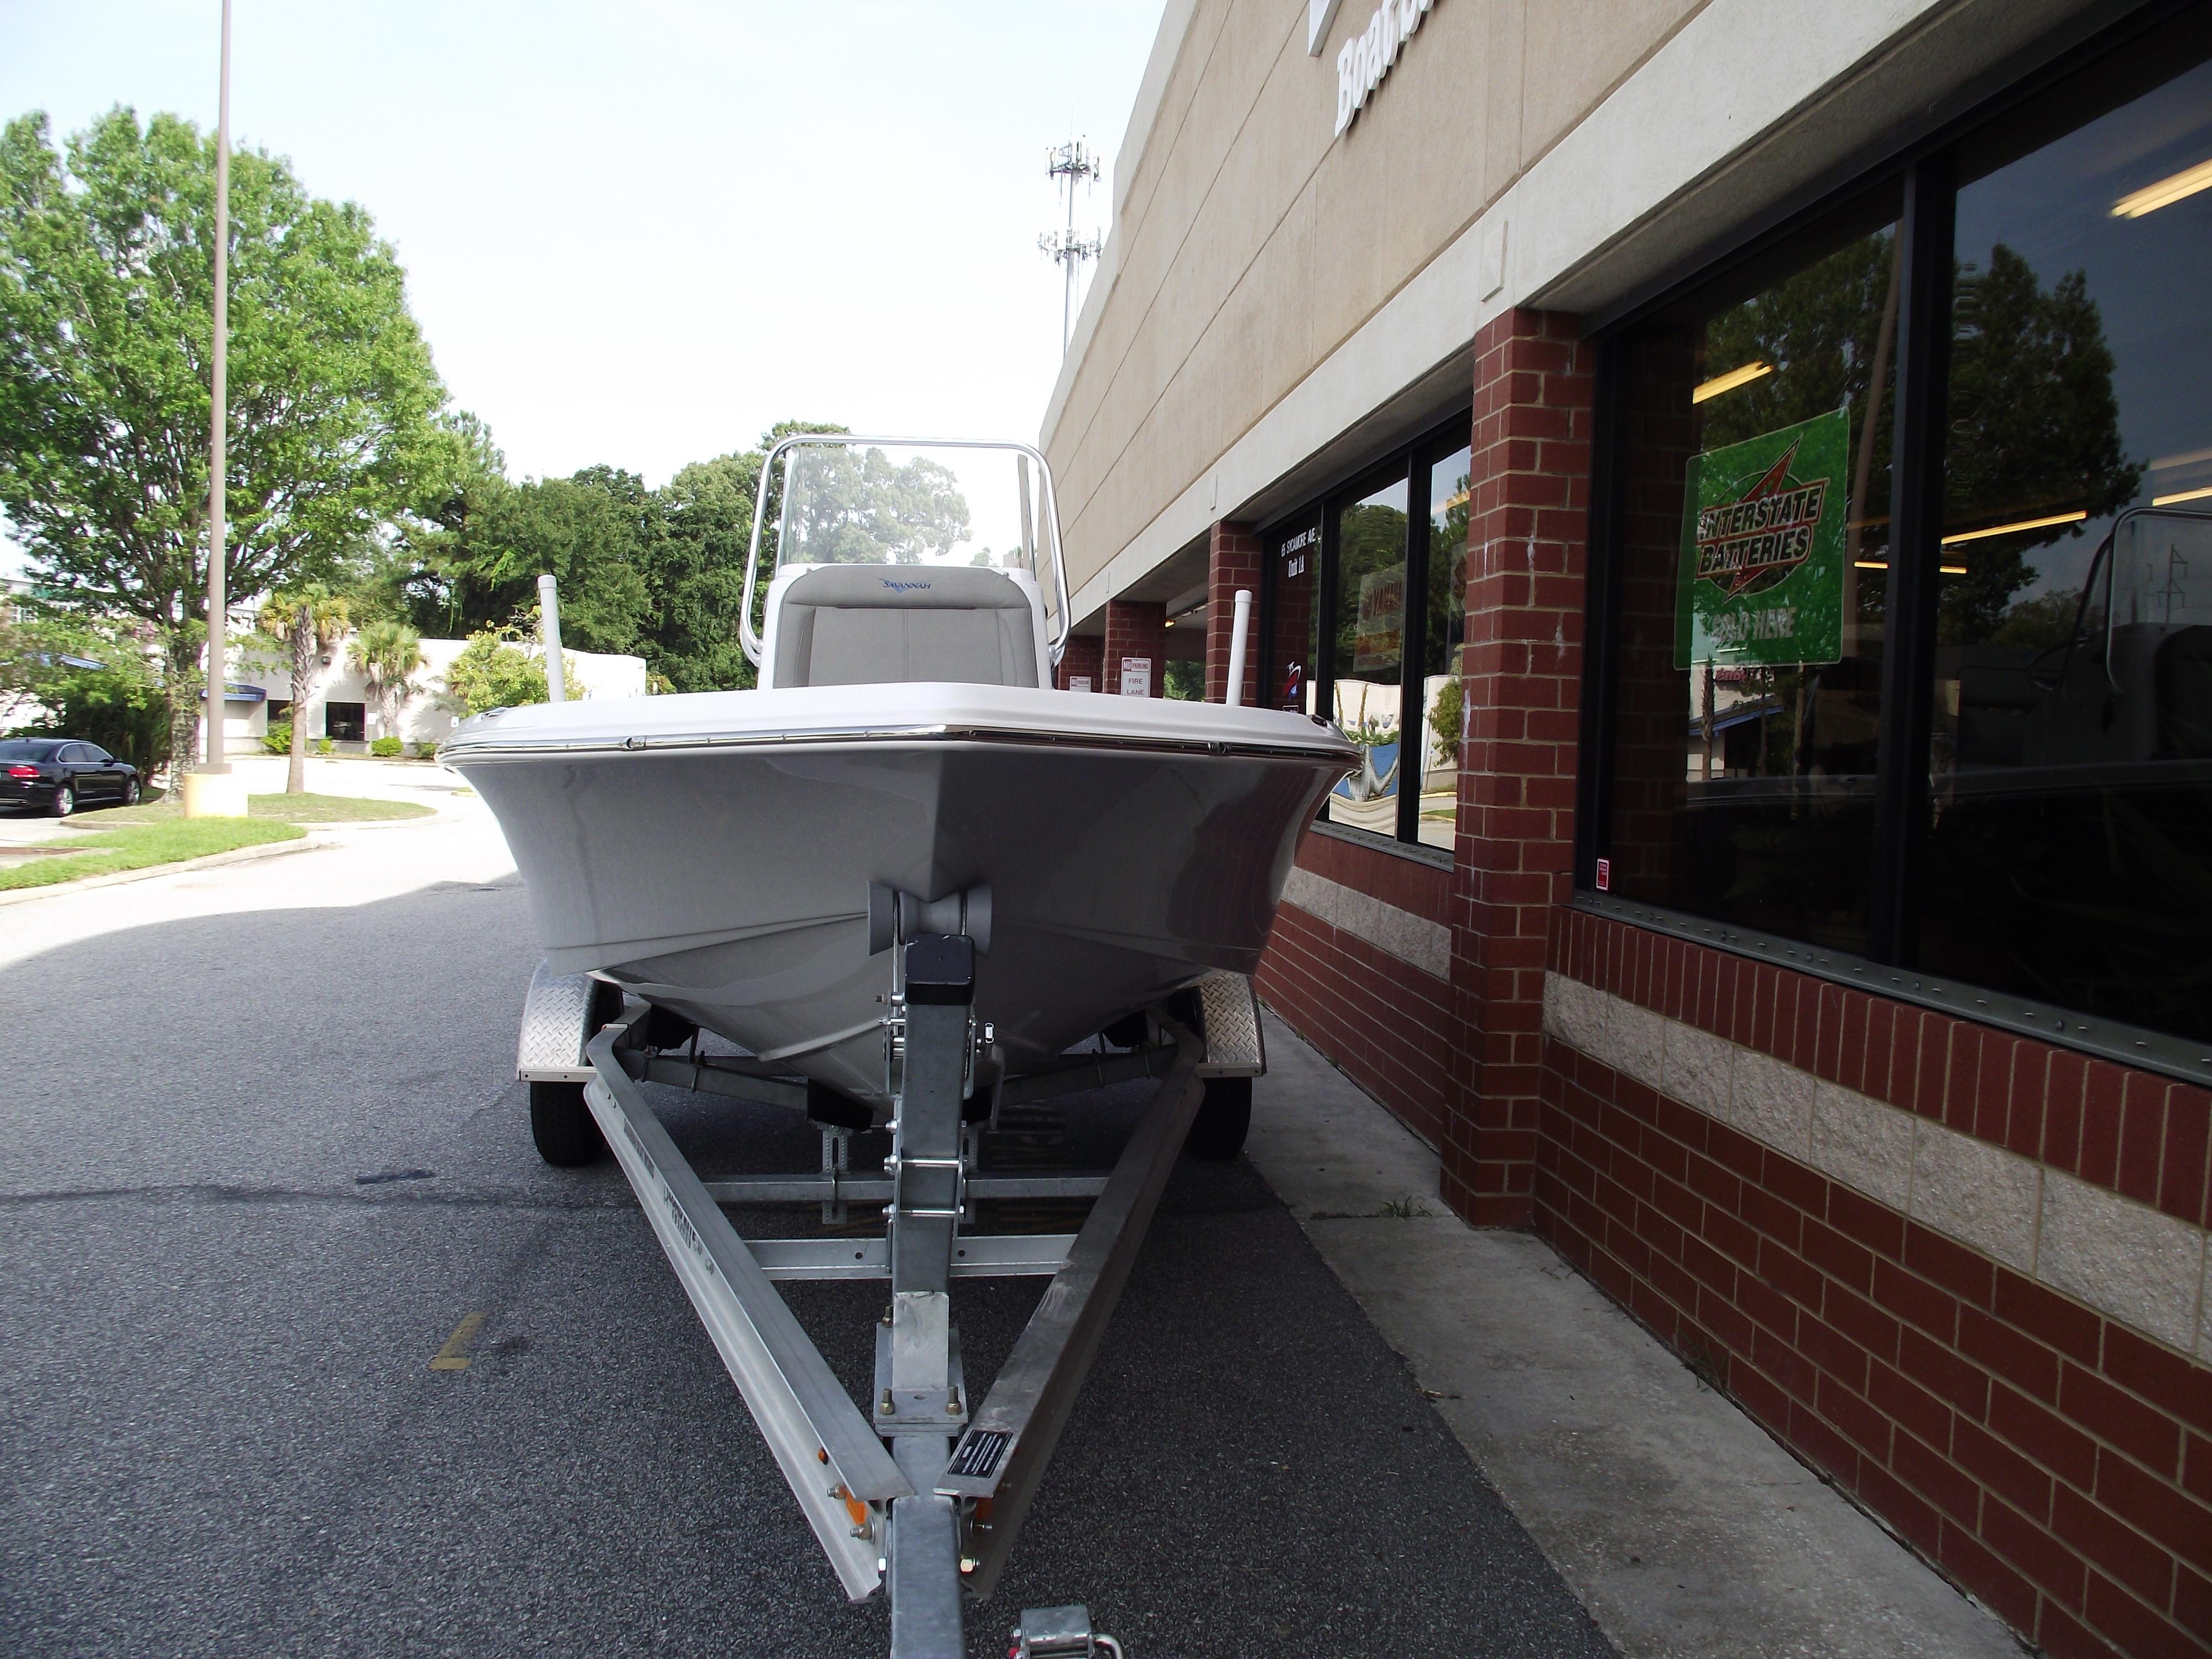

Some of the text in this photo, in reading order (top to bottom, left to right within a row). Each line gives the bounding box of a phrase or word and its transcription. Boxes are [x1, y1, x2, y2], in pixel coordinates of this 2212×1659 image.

[1699, 488, 1821, 540] INTERSTATE
[1700, 527, 1809, 573] BATTERIES
[1753, 607, 1797, 640] HERE
[1124, 660, 1131, 670] NO
